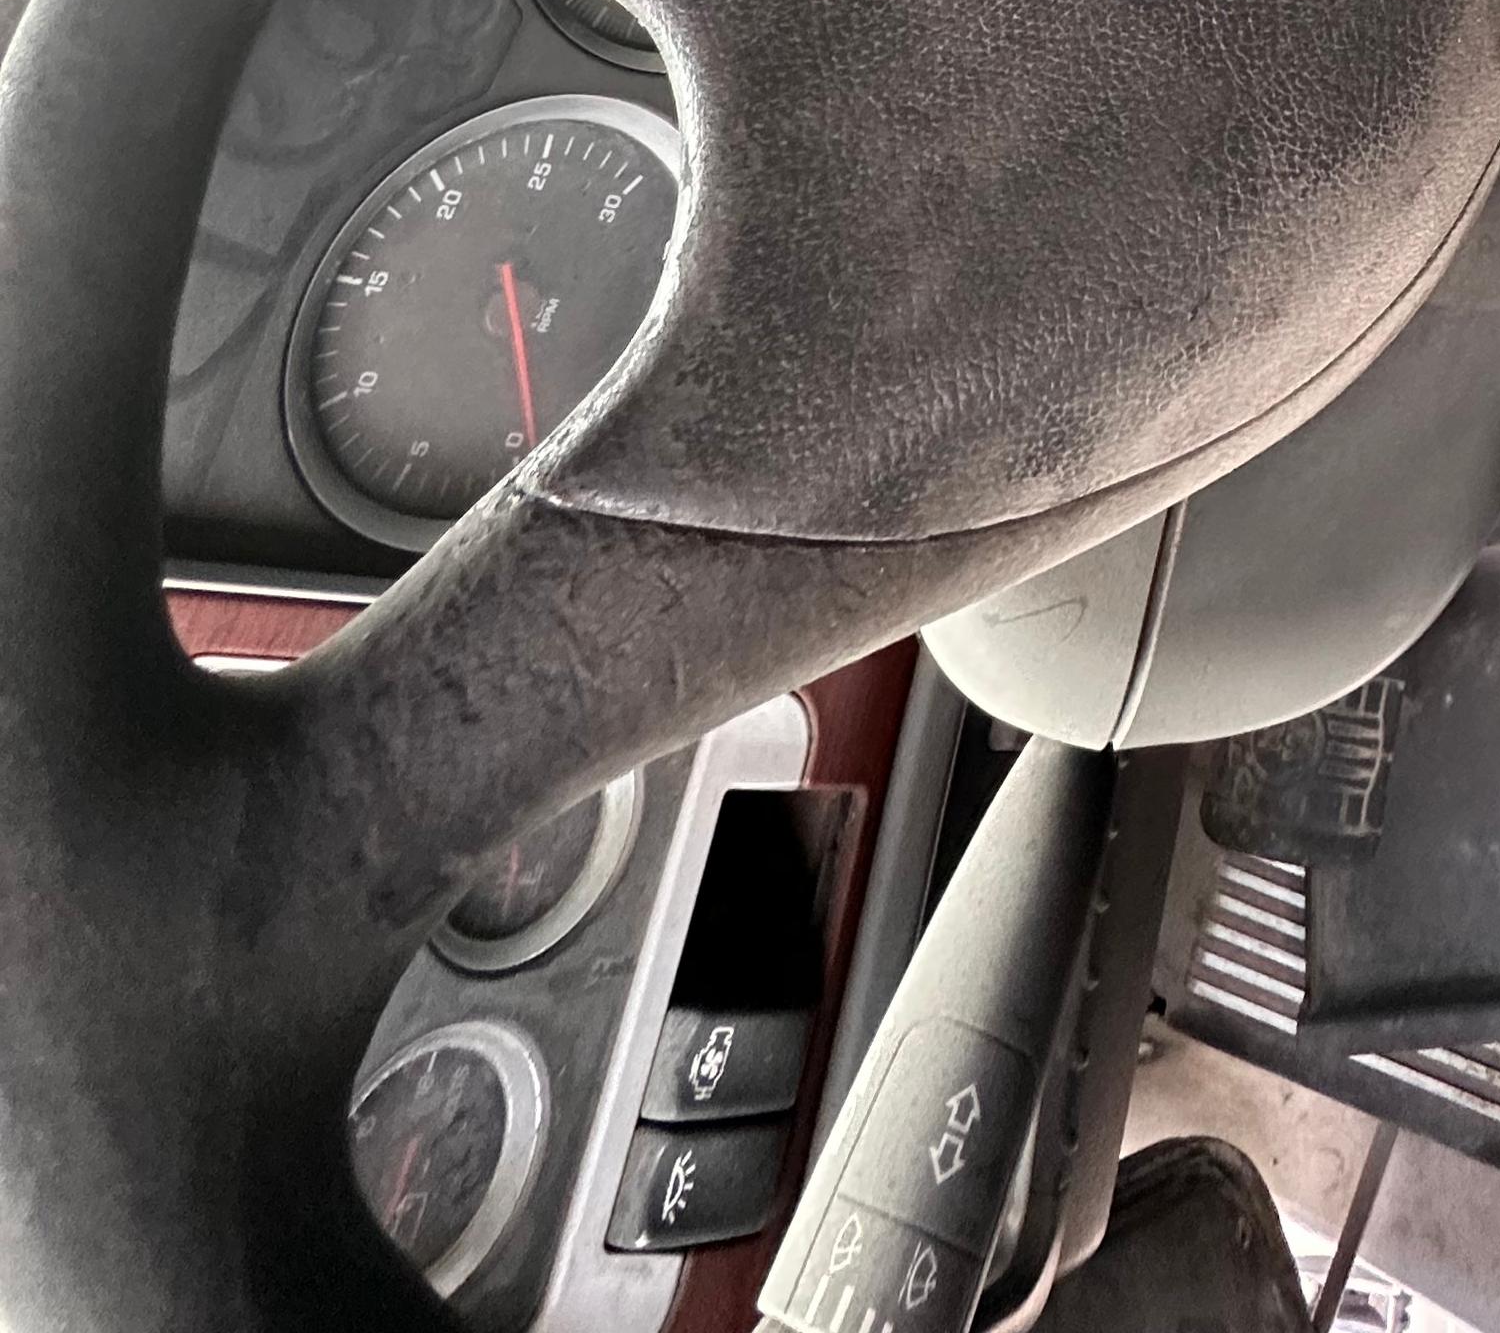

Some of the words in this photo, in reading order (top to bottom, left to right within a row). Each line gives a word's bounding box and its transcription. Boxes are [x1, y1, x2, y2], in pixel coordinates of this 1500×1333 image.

[527, 162, 552, 191] 25
[436, 189, 463, 220] 20
[599, 194, 622, 223] 30
[364, 270, 389, 297] 15
[537, 298, 560, 333] RPM
[353, 371, 379, 398] 10
[411, 440, 430, 458] 5
[505, 432, 524, 449] 0
